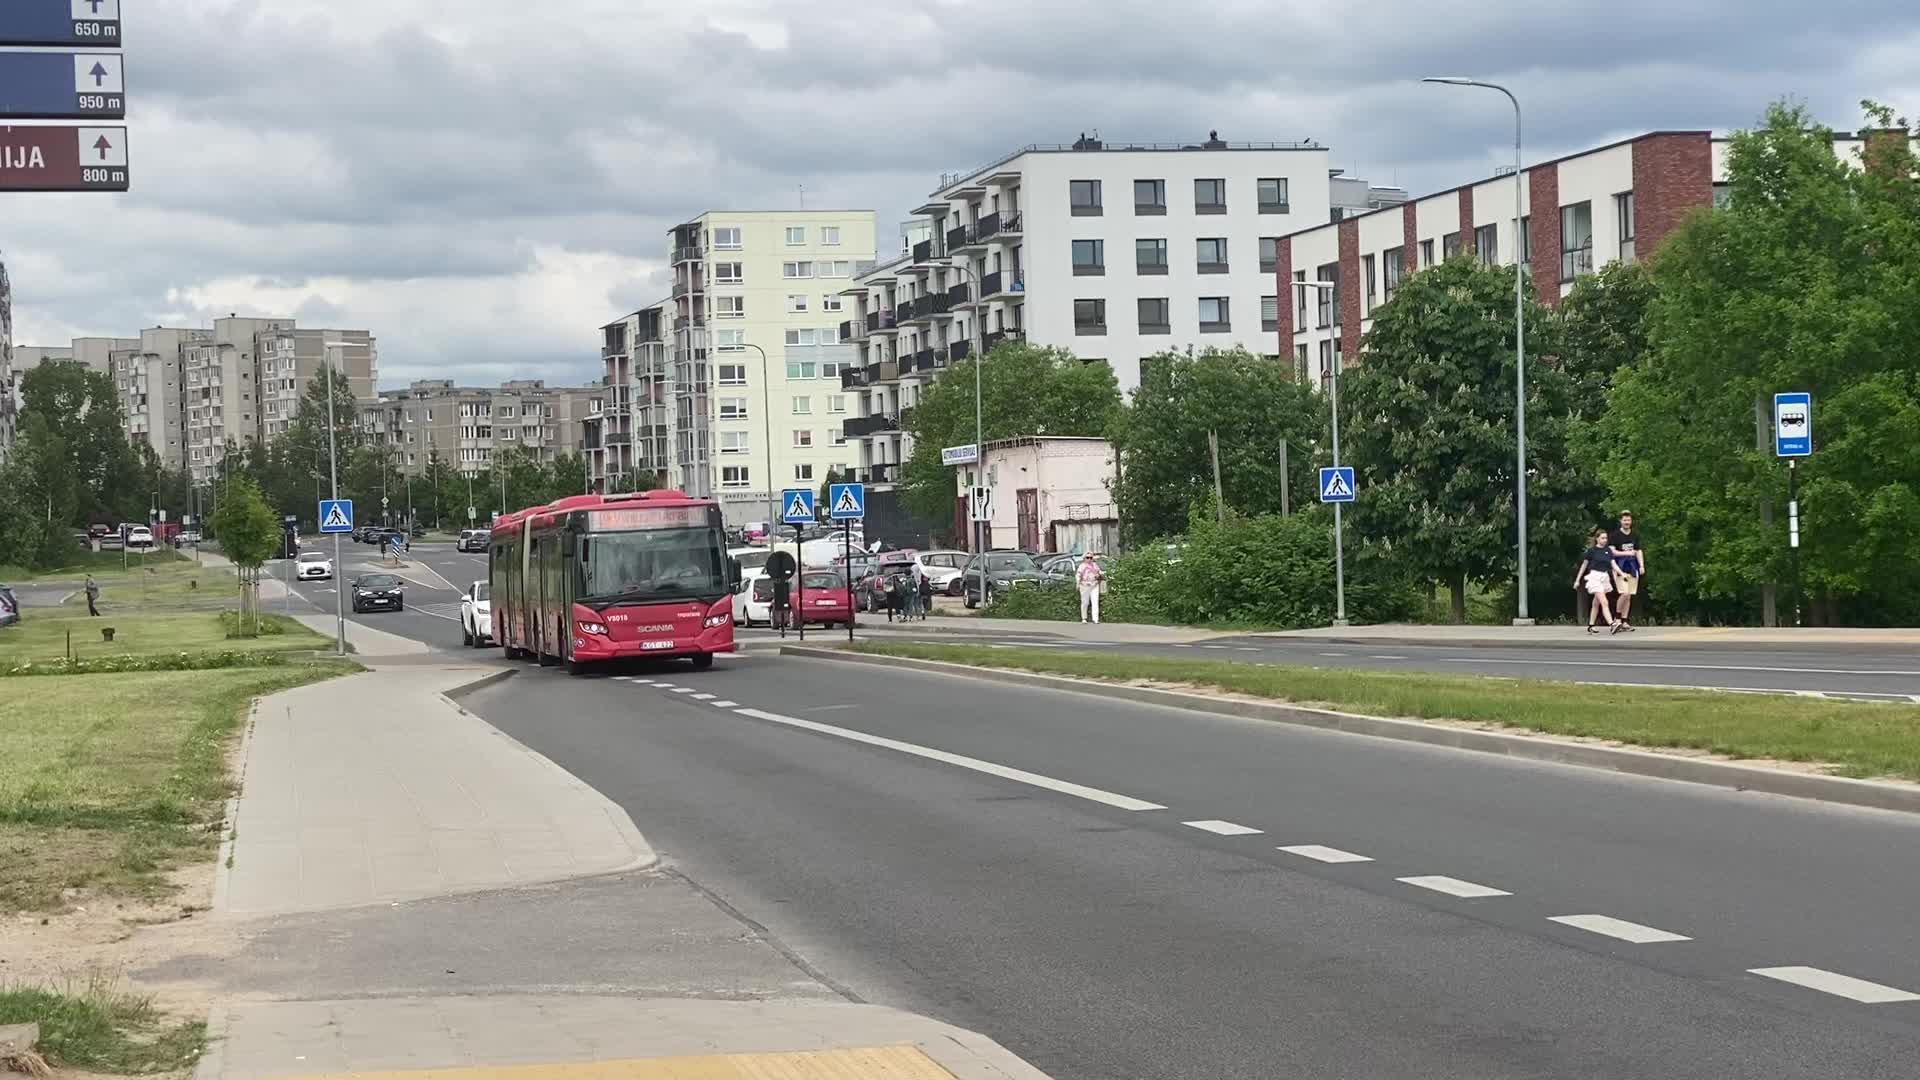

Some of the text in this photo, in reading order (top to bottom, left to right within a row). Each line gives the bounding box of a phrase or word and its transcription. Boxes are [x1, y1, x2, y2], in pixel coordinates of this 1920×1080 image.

[75, 23, 116, 36] 650 m
[79, 96, 121, 109] 950 m
[0, 145, 45, 169] IJA
[83, 169, 125, 182] 800 m
[638, 624, 674, 633] SCANIA
